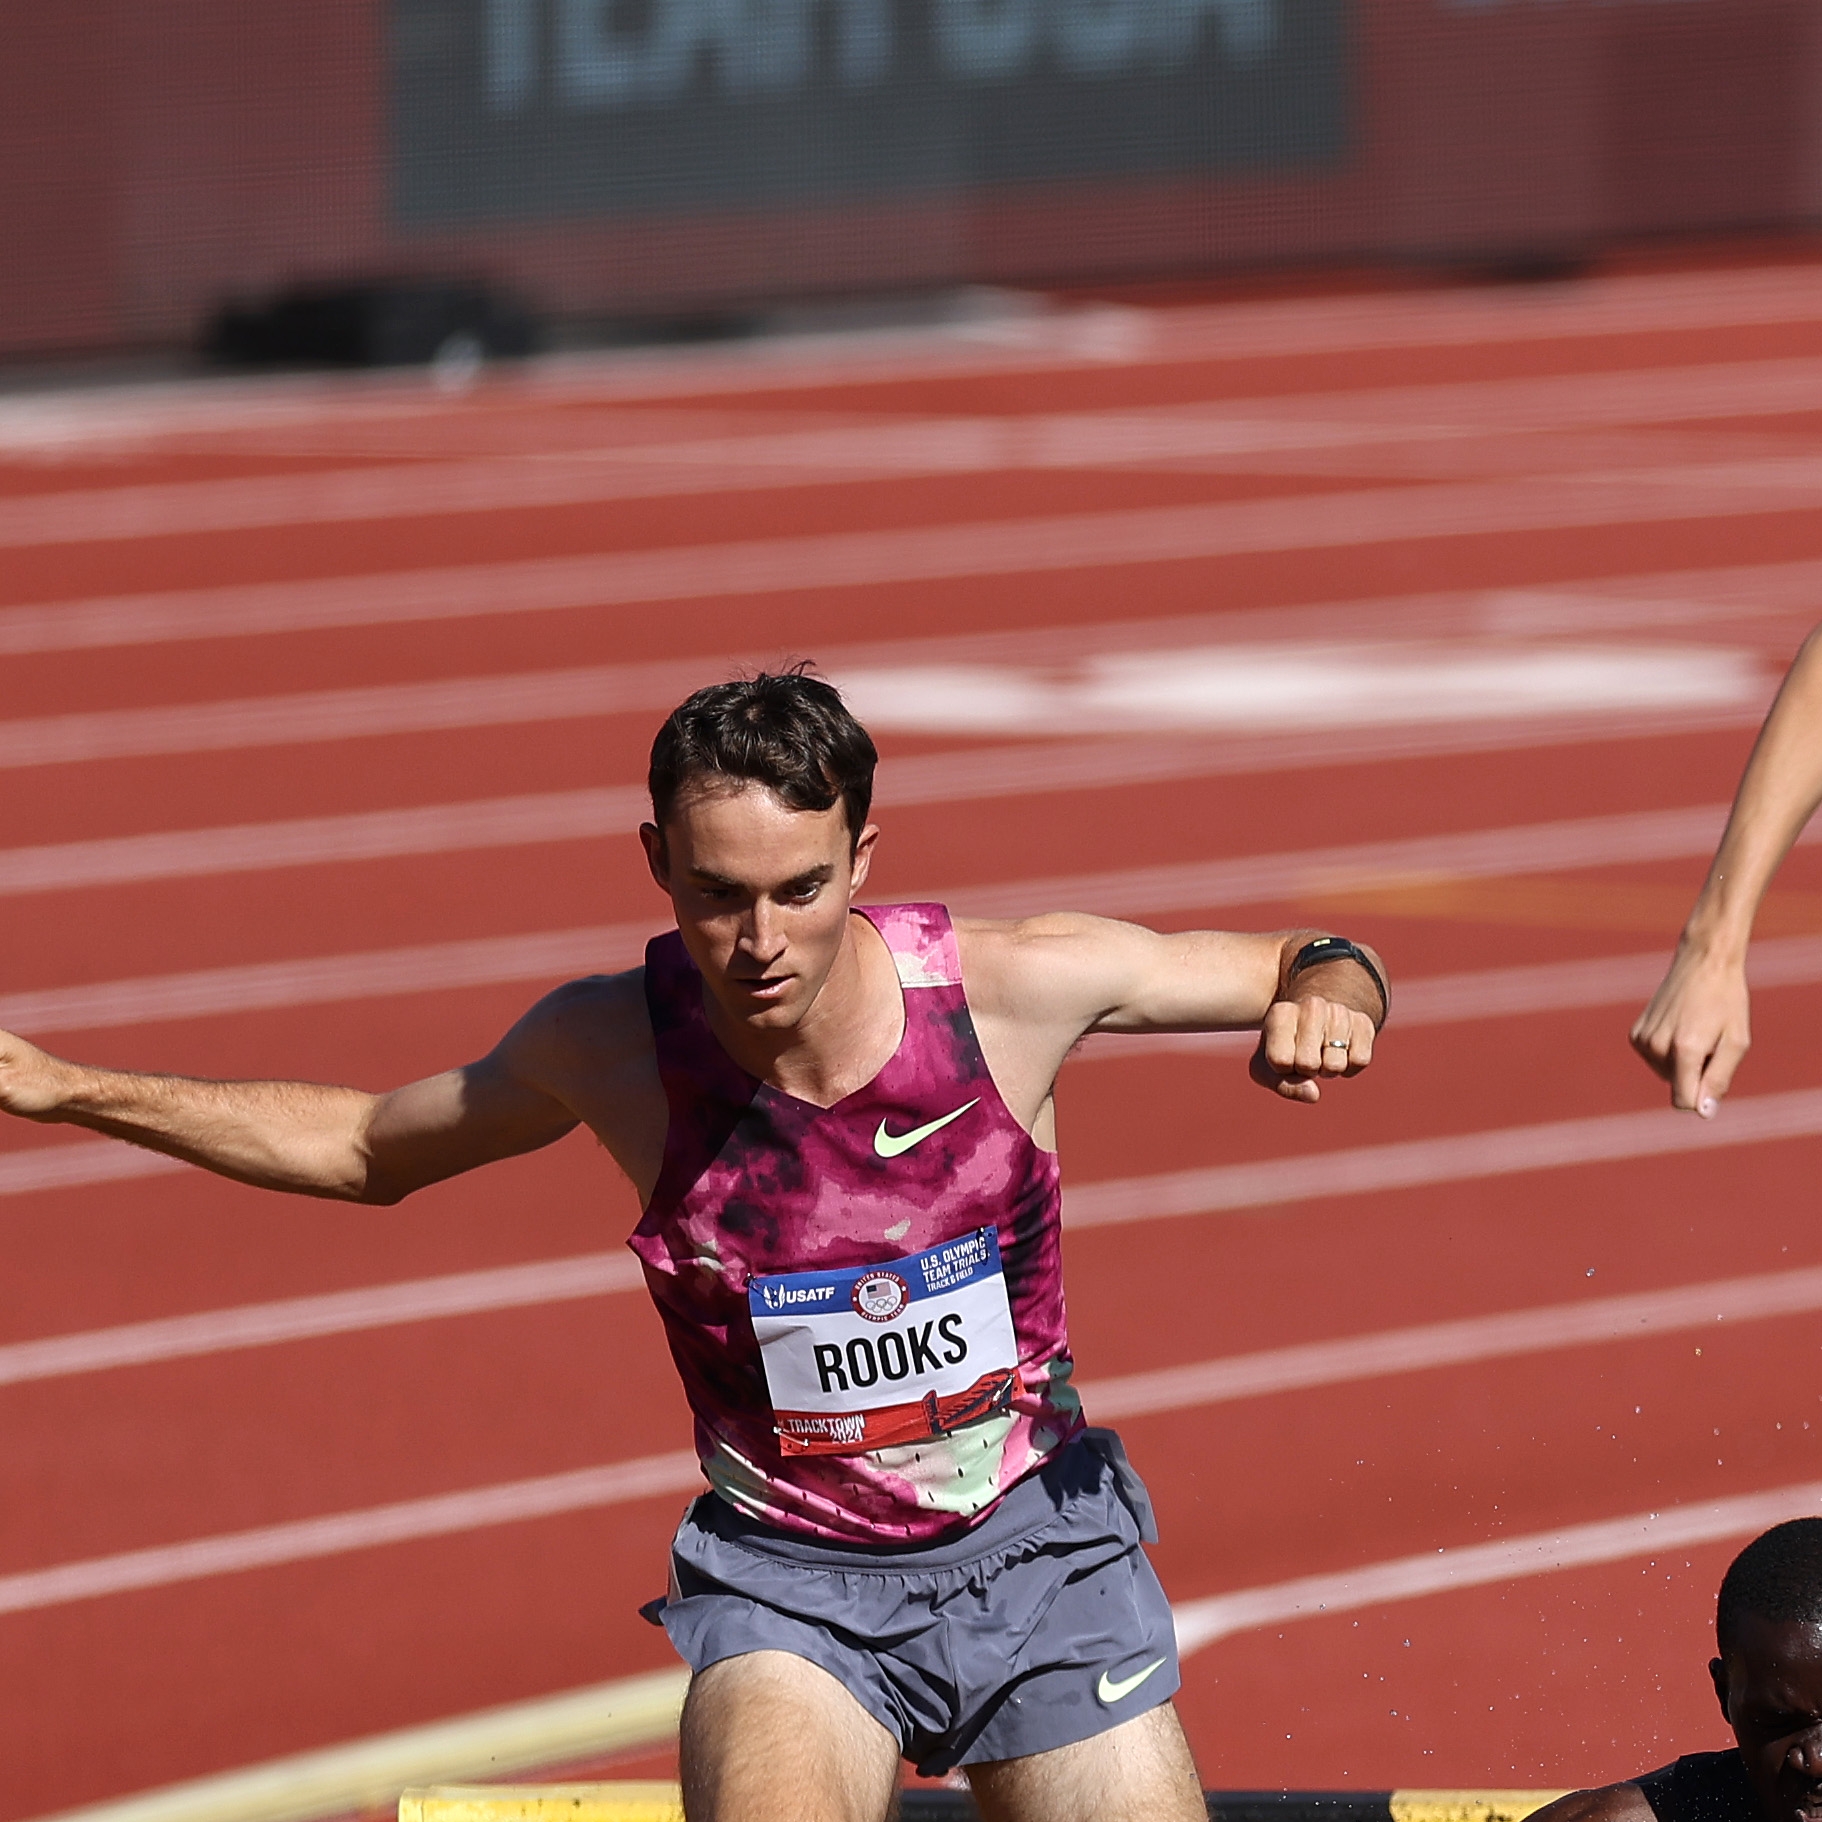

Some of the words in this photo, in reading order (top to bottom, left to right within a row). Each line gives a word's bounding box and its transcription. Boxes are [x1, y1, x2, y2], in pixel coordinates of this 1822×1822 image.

[920, 1257, 942, 1271] U.S.
[943, 1237, 986, 1262] OLYMPIC
[923, 1267, 951, 1283] TEAM
[926, 1279, 951, 1292] TRACK
[956, 1267, 973, 1281] FIELD
[786, 1286, 836, 1303] USATF
[813, 1313, 968, 1393] ROOKS
